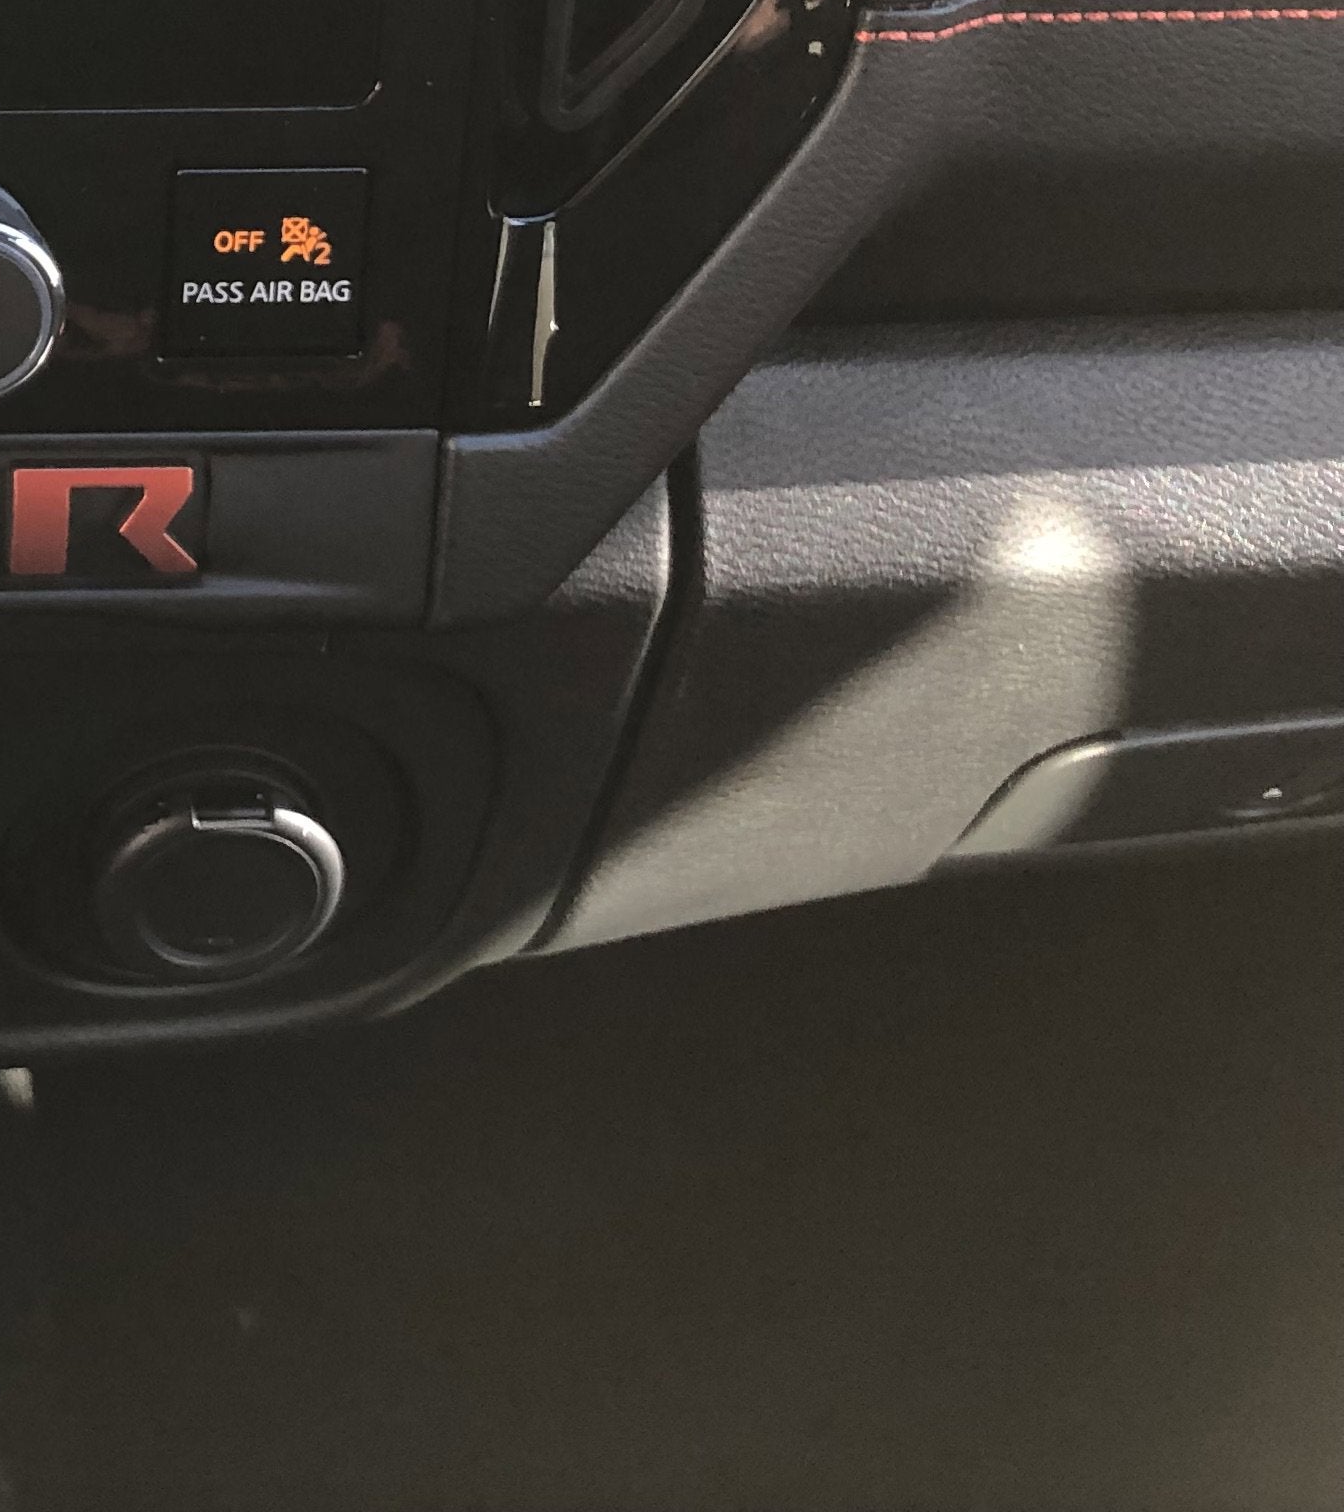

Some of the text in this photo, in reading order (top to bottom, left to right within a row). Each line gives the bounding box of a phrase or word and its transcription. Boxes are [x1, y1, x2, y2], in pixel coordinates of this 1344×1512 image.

[213, 230, 266, 254] OFF
[181, 280, 352, 304] PASS AIR BAG
